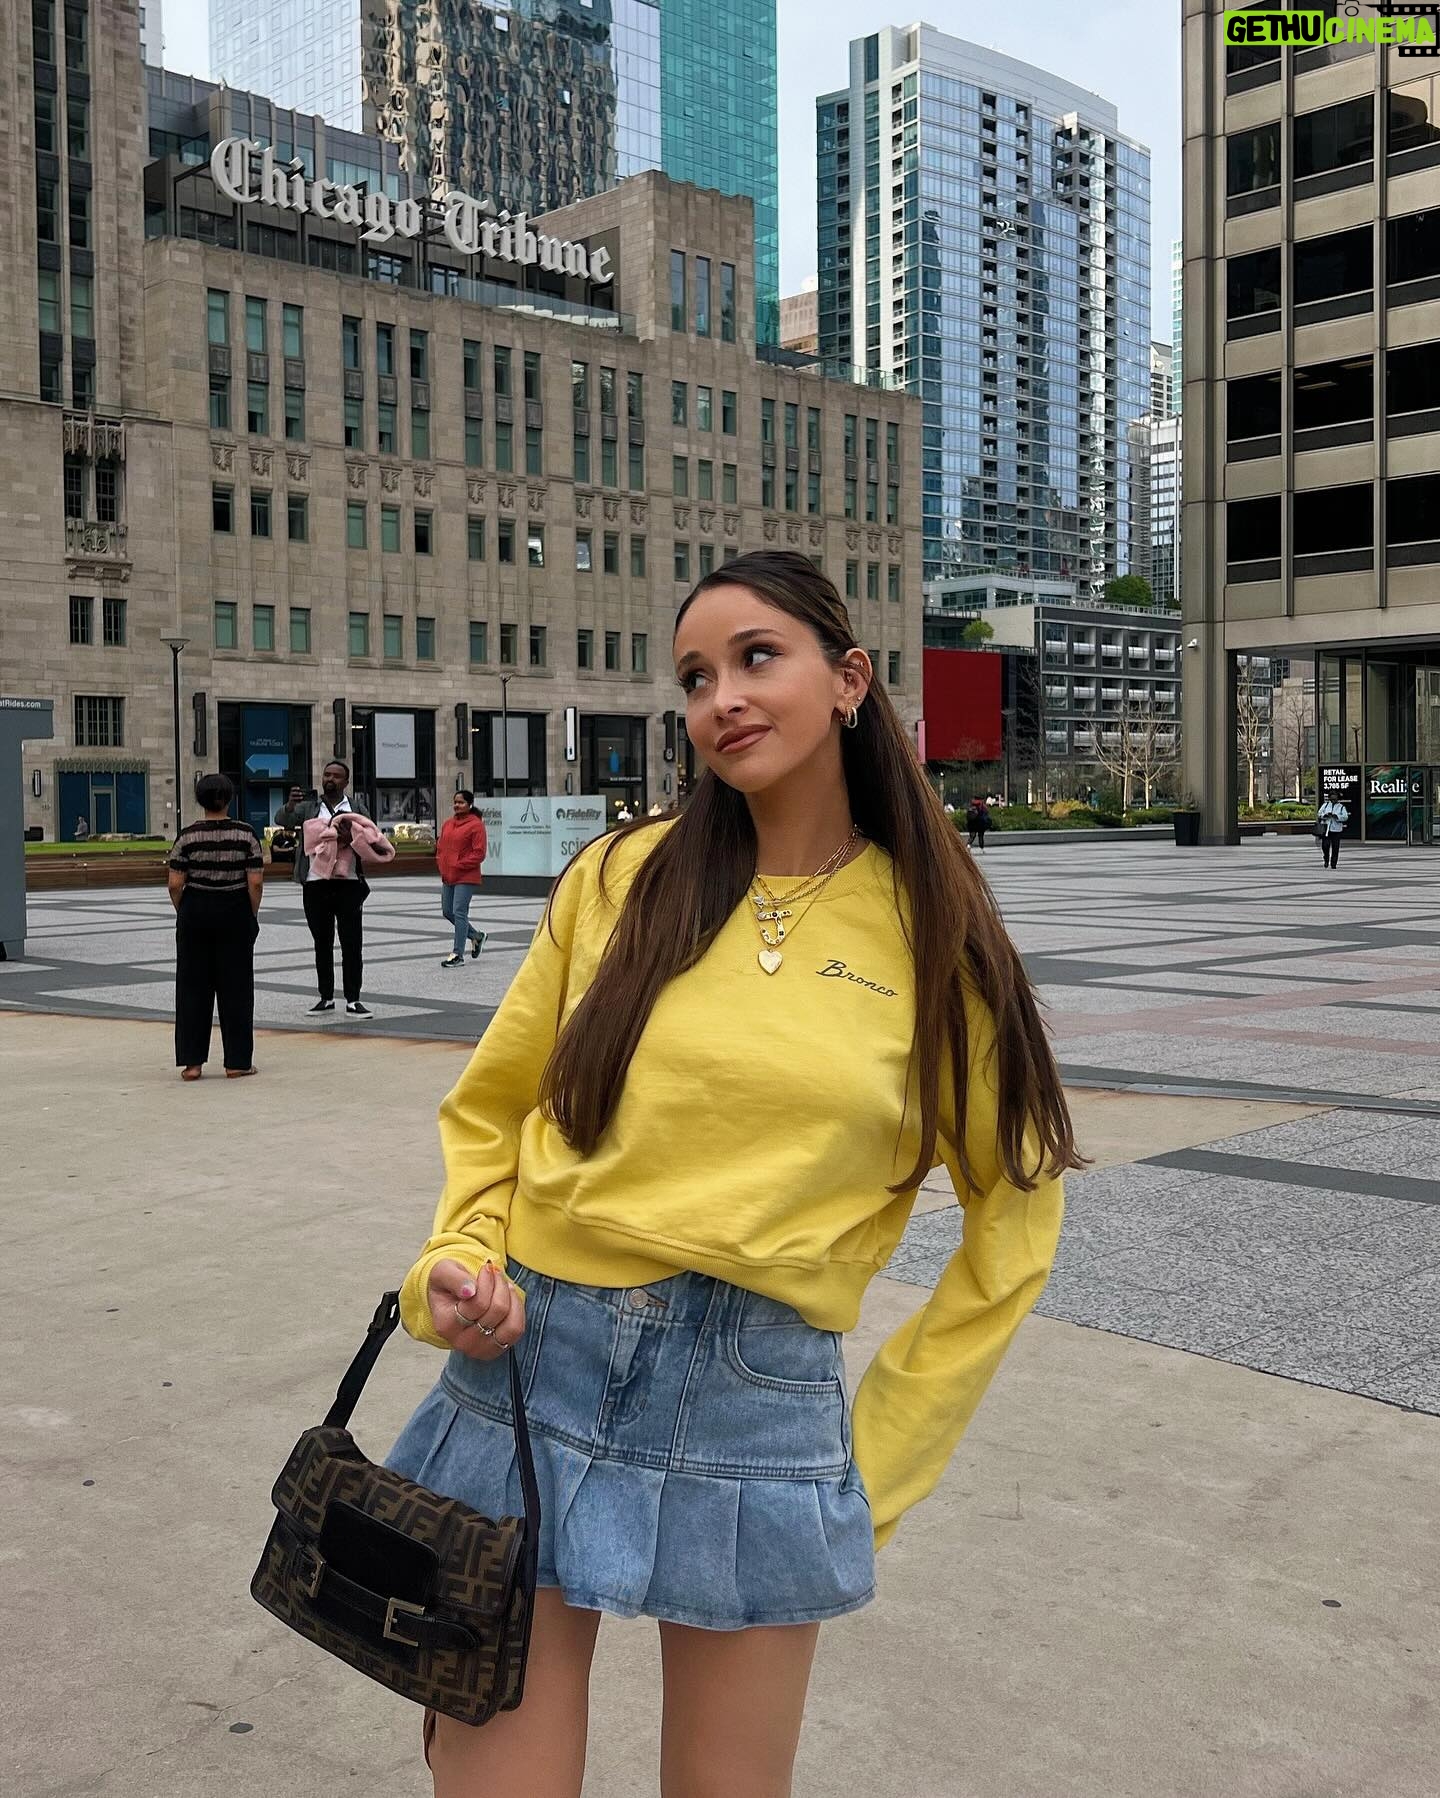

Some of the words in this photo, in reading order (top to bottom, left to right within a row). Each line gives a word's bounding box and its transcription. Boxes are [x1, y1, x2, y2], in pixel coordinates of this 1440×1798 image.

[210, 136, 424, 242] Chicago
[444, 190, 615, 284] Tribune
[1370, 779, 1420, 794] Realie
[816, 959, 898, 997] Bronco
